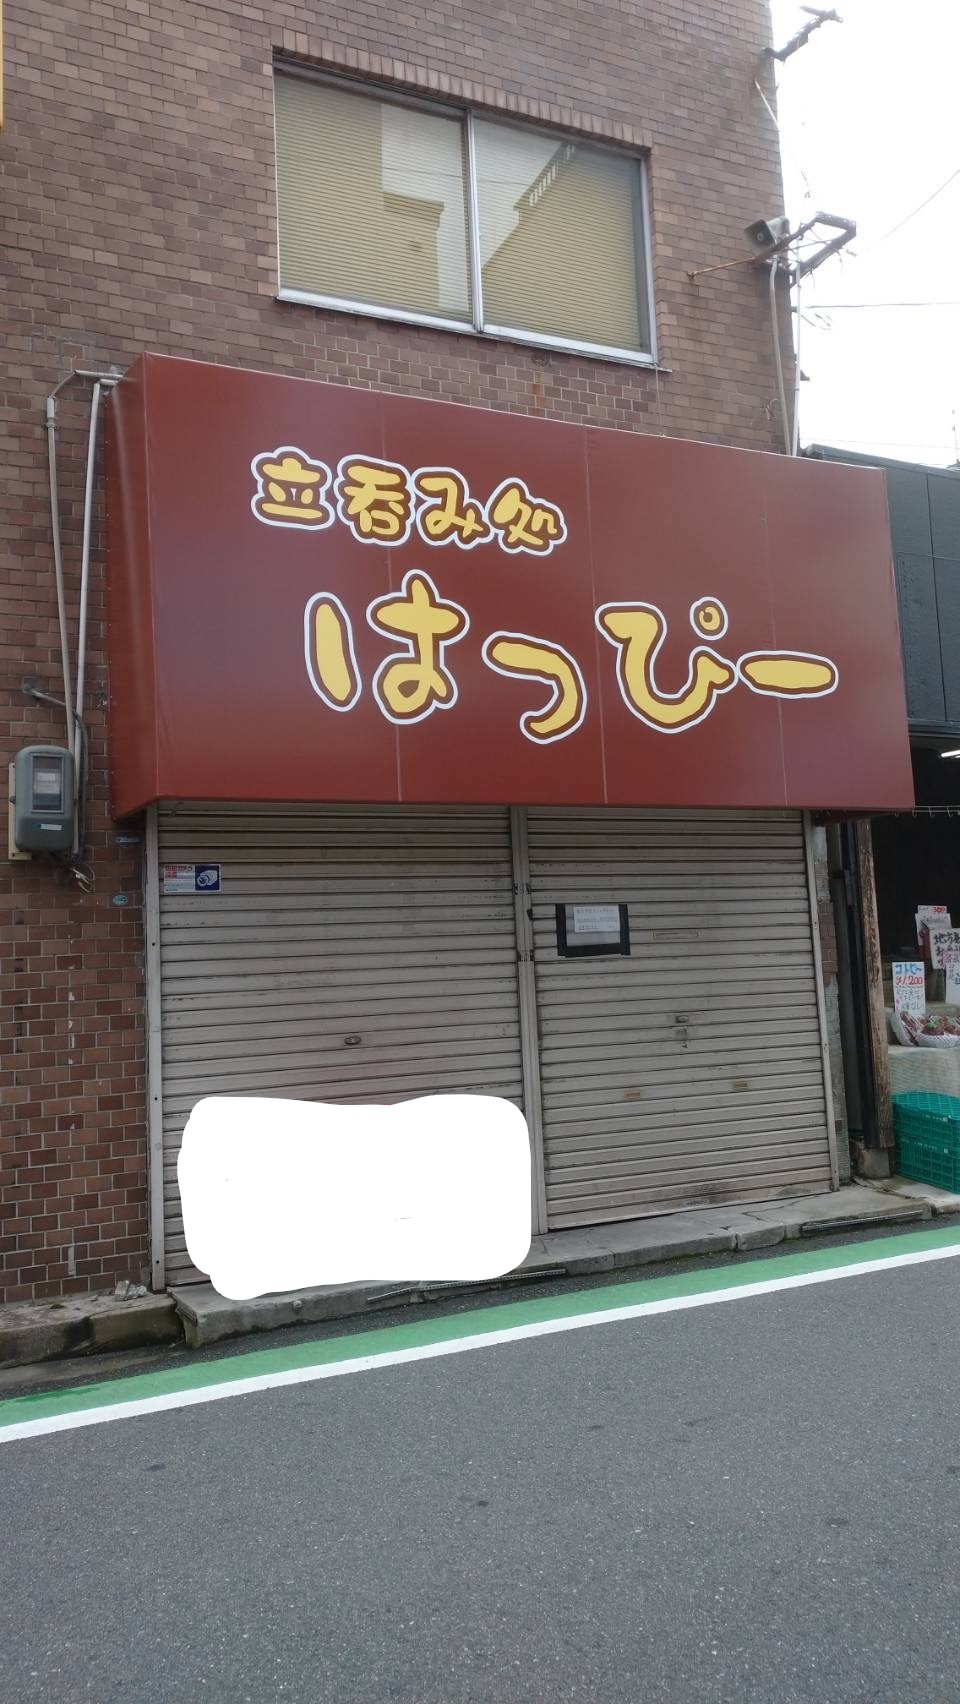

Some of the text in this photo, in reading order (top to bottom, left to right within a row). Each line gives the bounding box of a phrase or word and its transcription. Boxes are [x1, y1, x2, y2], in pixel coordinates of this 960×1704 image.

[253, 448, 566, 553] 立呑み処
[307, 572, 837, 742] はっぴー
